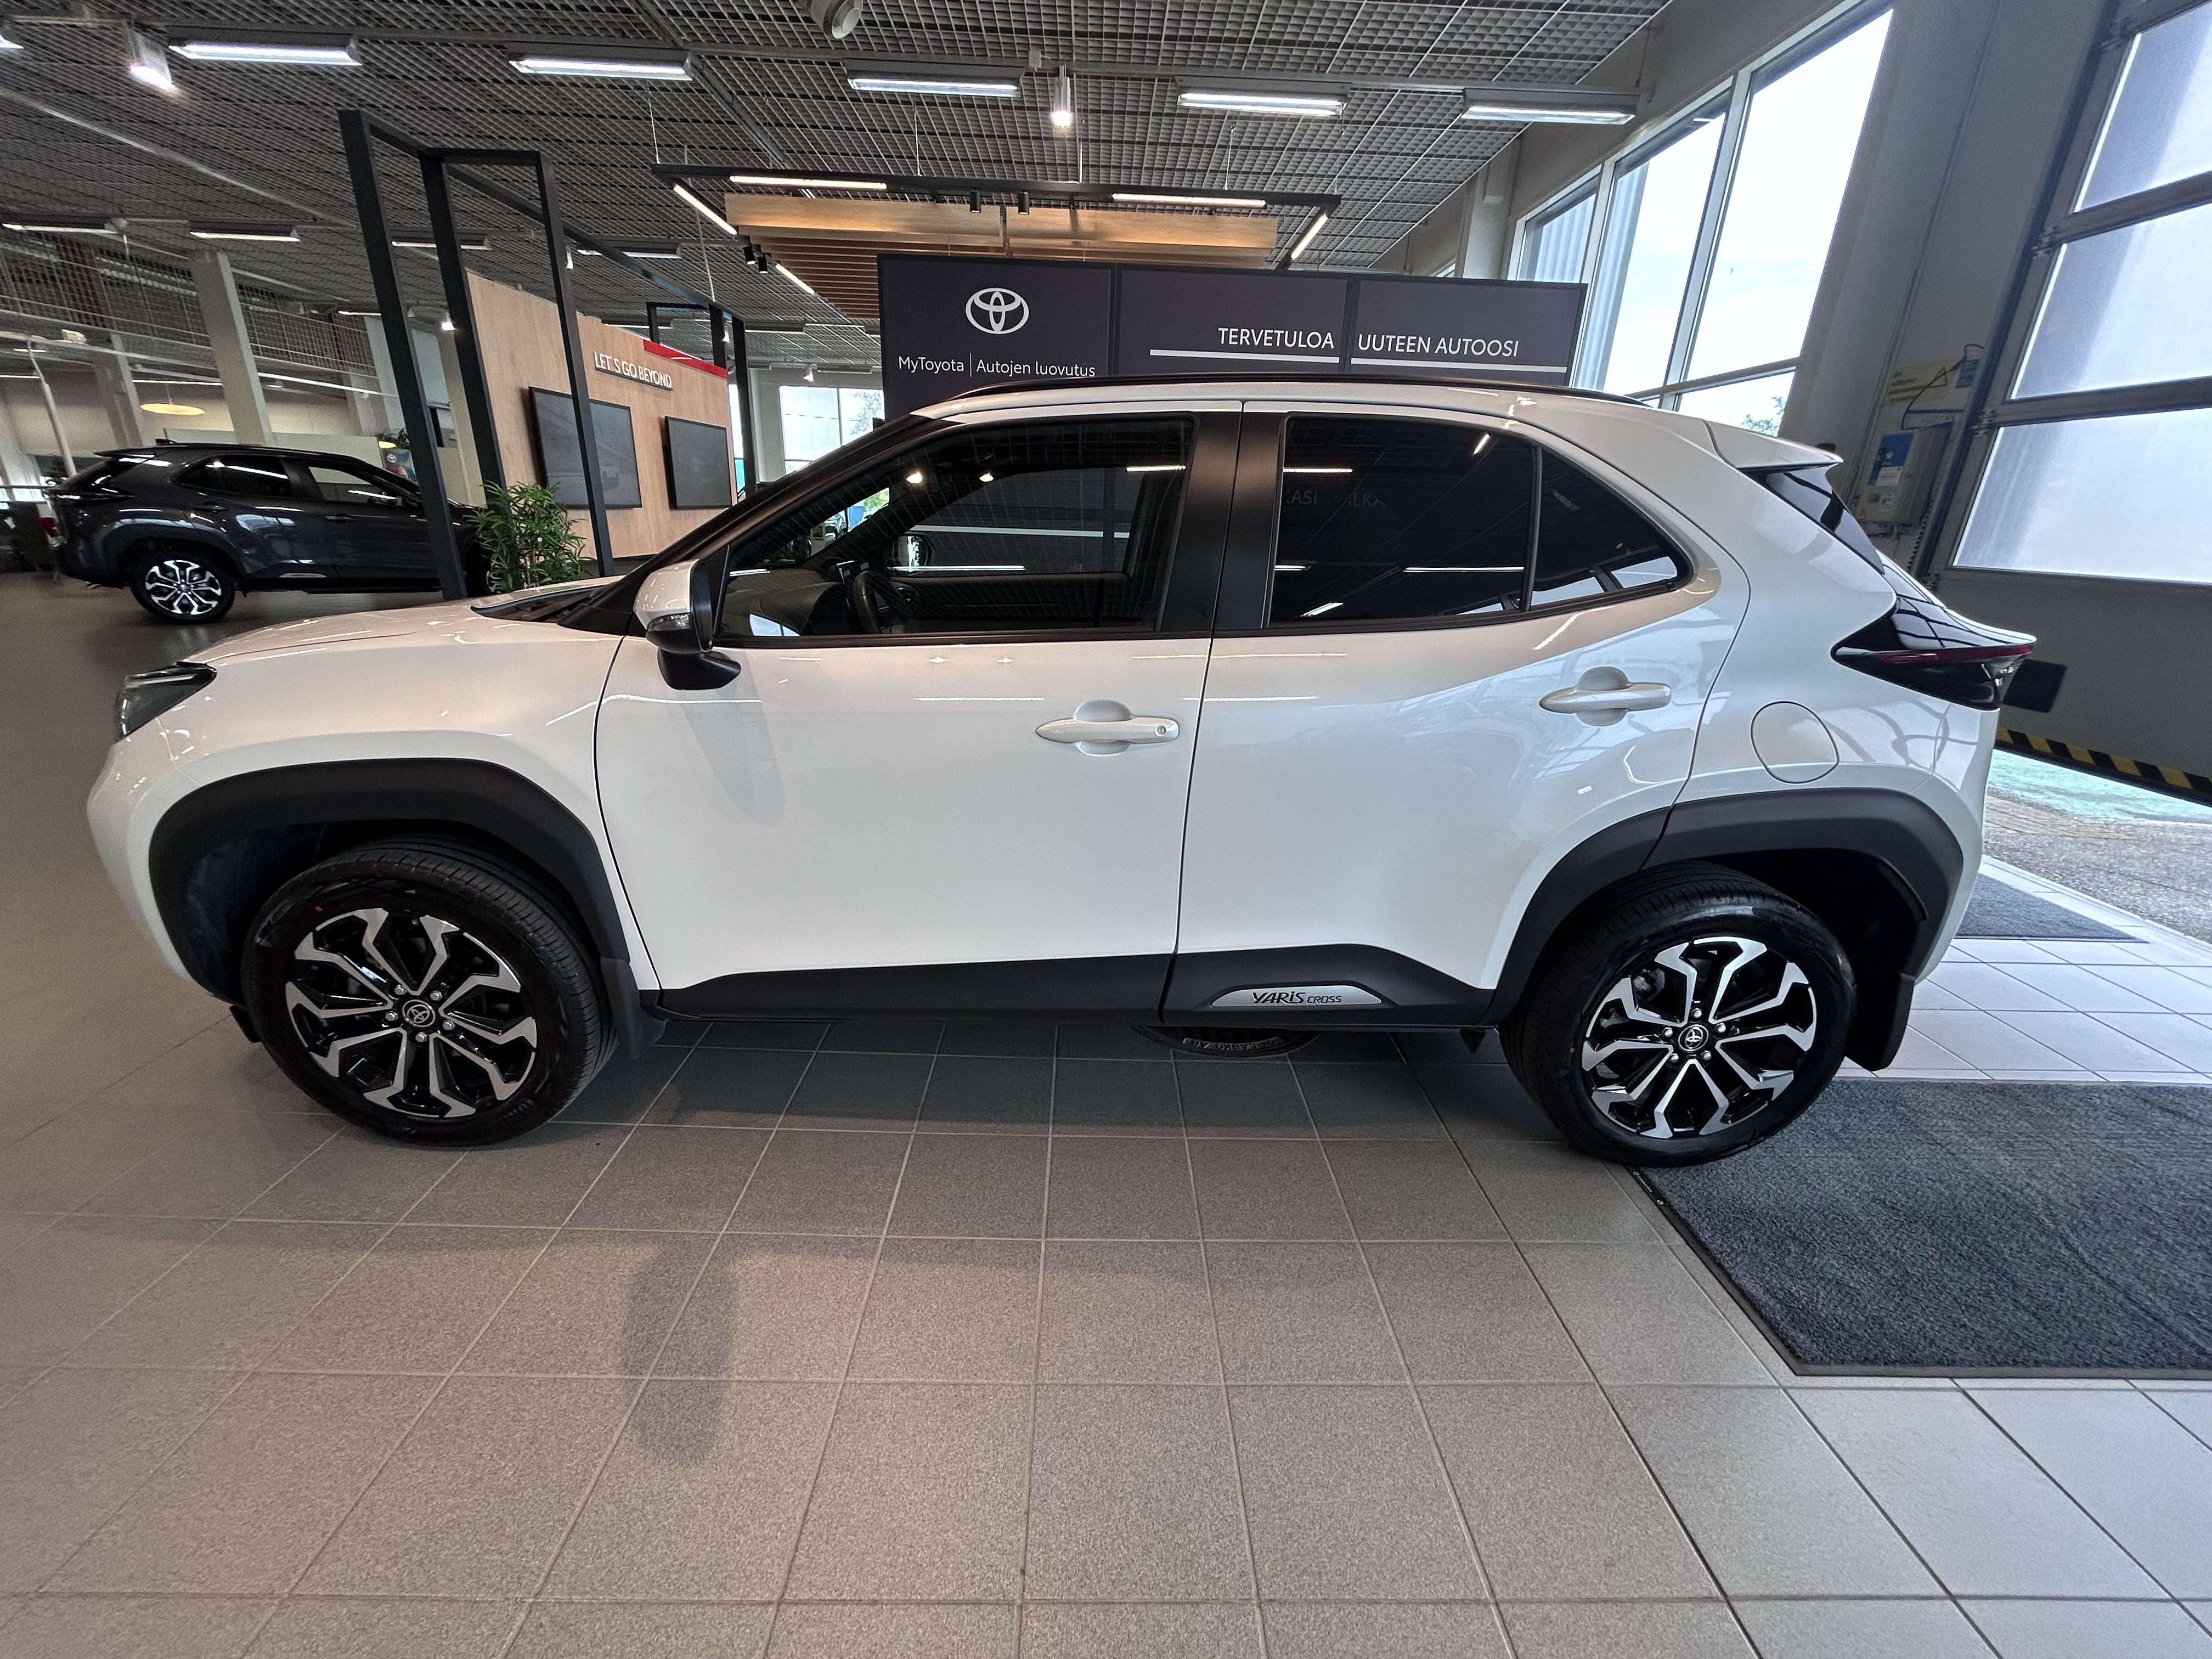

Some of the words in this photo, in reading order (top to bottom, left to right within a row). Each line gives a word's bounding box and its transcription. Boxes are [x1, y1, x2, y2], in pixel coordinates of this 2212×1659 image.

[1218, 327, 1335, 349] TERVETULOA
[1358, 334, 1430, 353] UUTEEN
[1435, 337, 1519, 357] AUTOOSI
[621, 360, 637, 379] GO
[637, 365, 672, 388] BEYOND
[898, 356, 964, 374] MyToyota
[976, 359, 1031, 377] Autojen
[1035, 361, 1096, 377] luovutus
[1307, 995, 1342, 1004] CROSS
